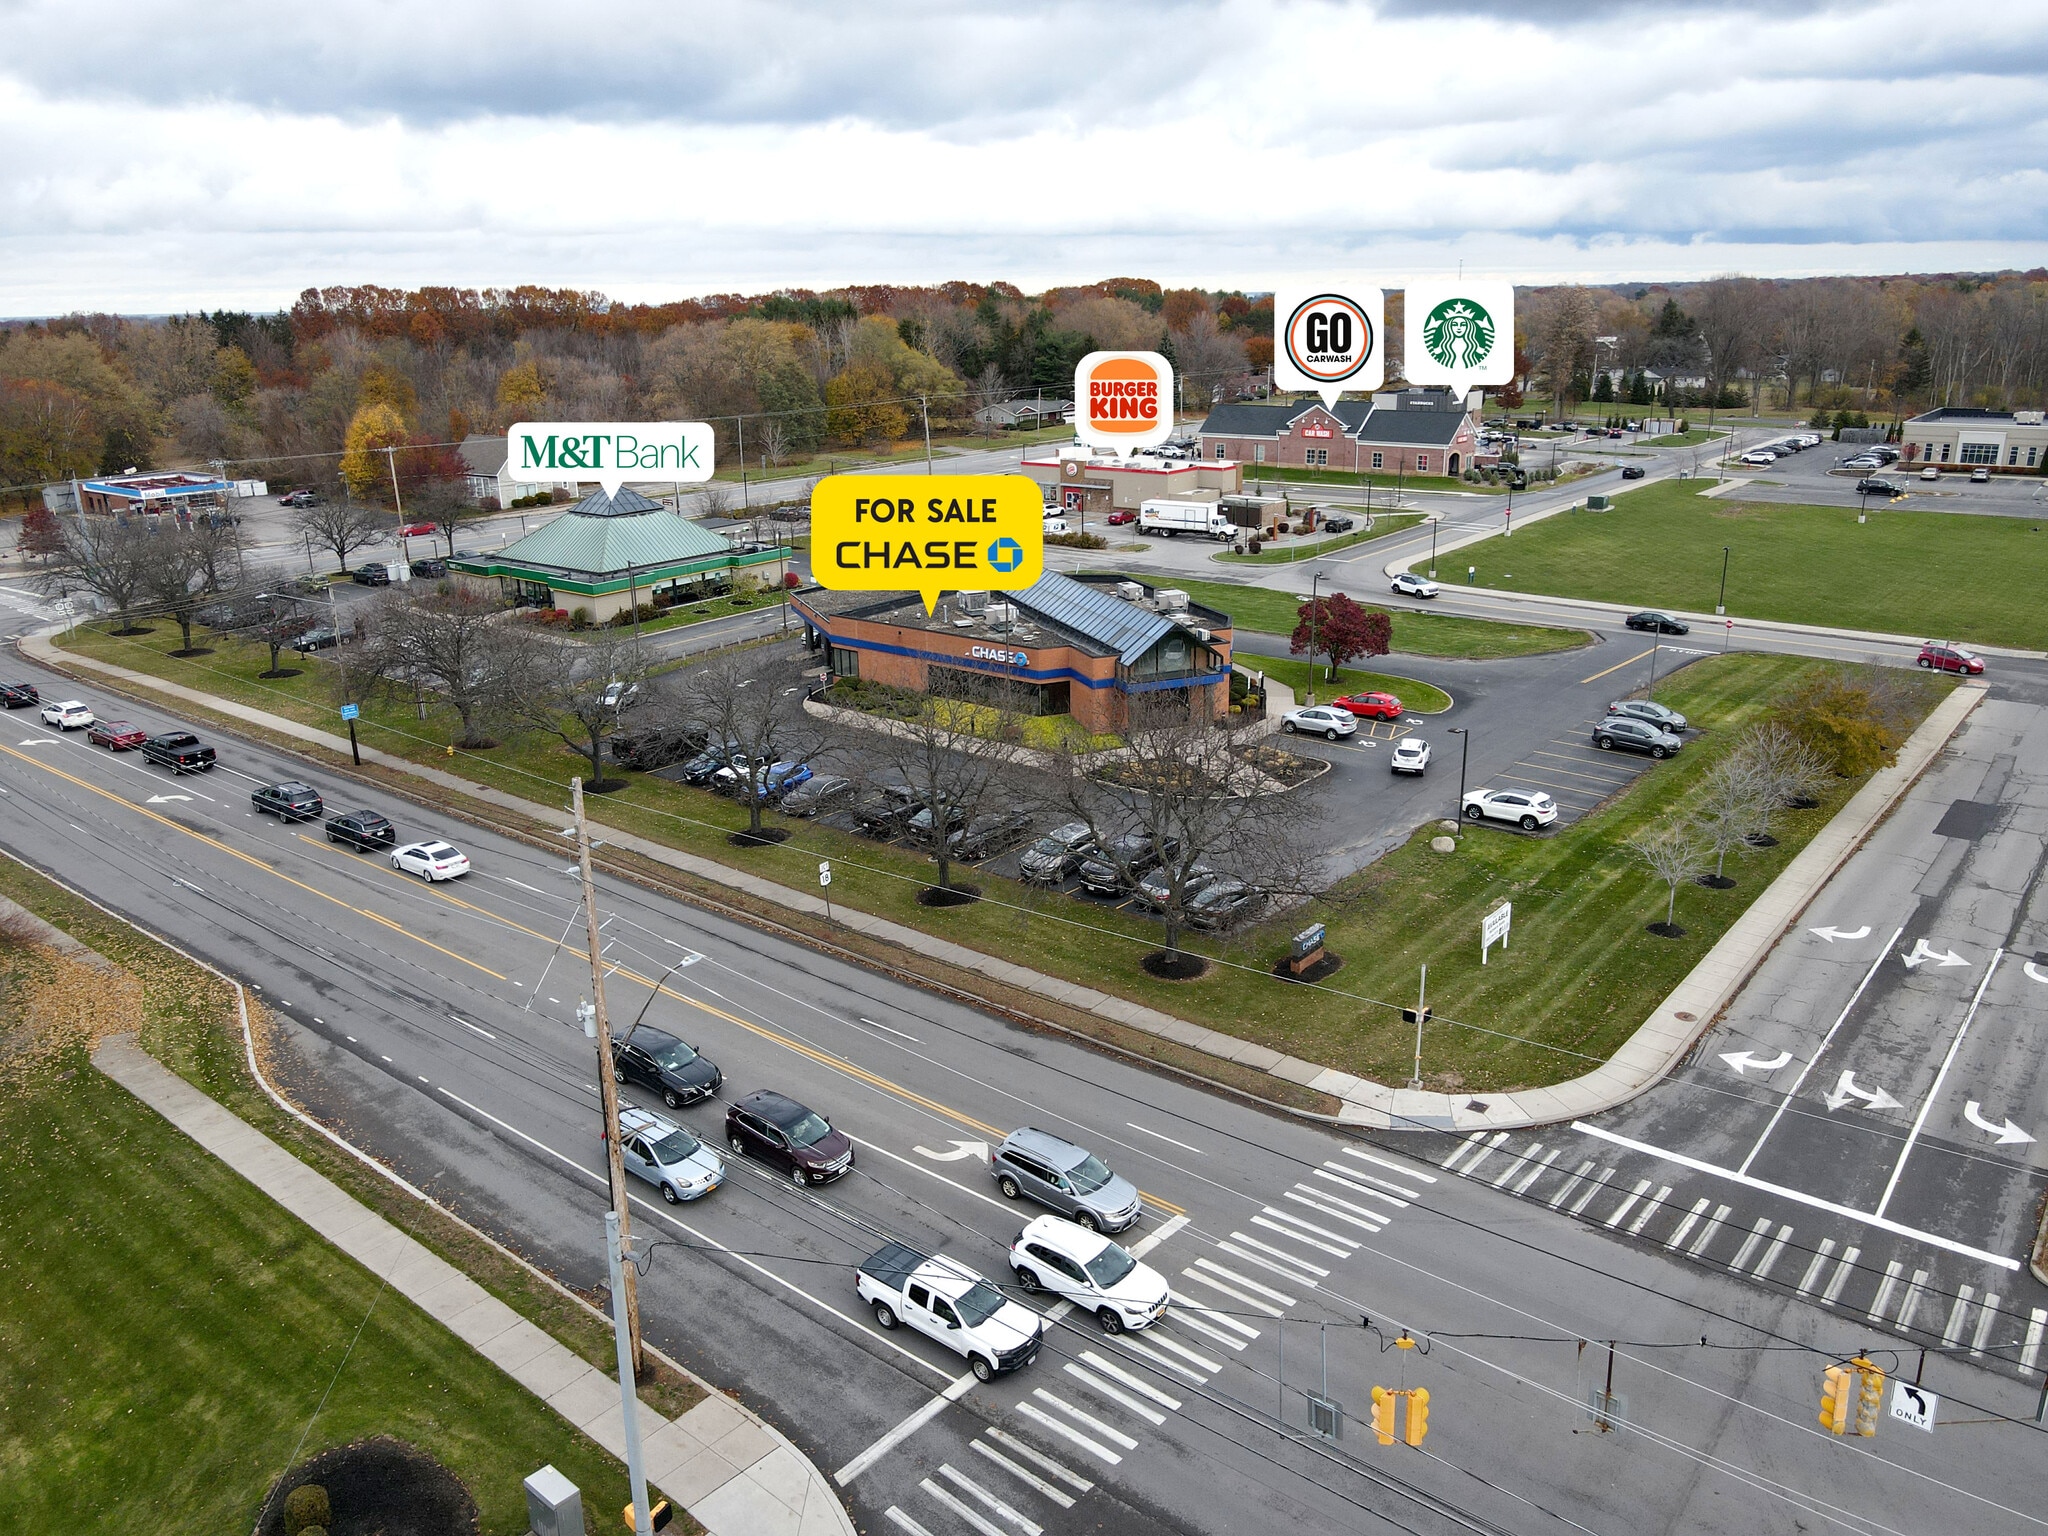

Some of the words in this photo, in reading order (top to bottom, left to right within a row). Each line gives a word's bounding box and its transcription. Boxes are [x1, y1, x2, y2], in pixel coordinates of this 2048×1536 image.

[144, 490, 165, 498] Mobil
[972, 646, 1015, 664] CHASE
[821, 873, 829, 883] 18
[1487, 909, 1509, 930] AVAILABLE
[1896, 1408, 1927, 1426] ONLY
